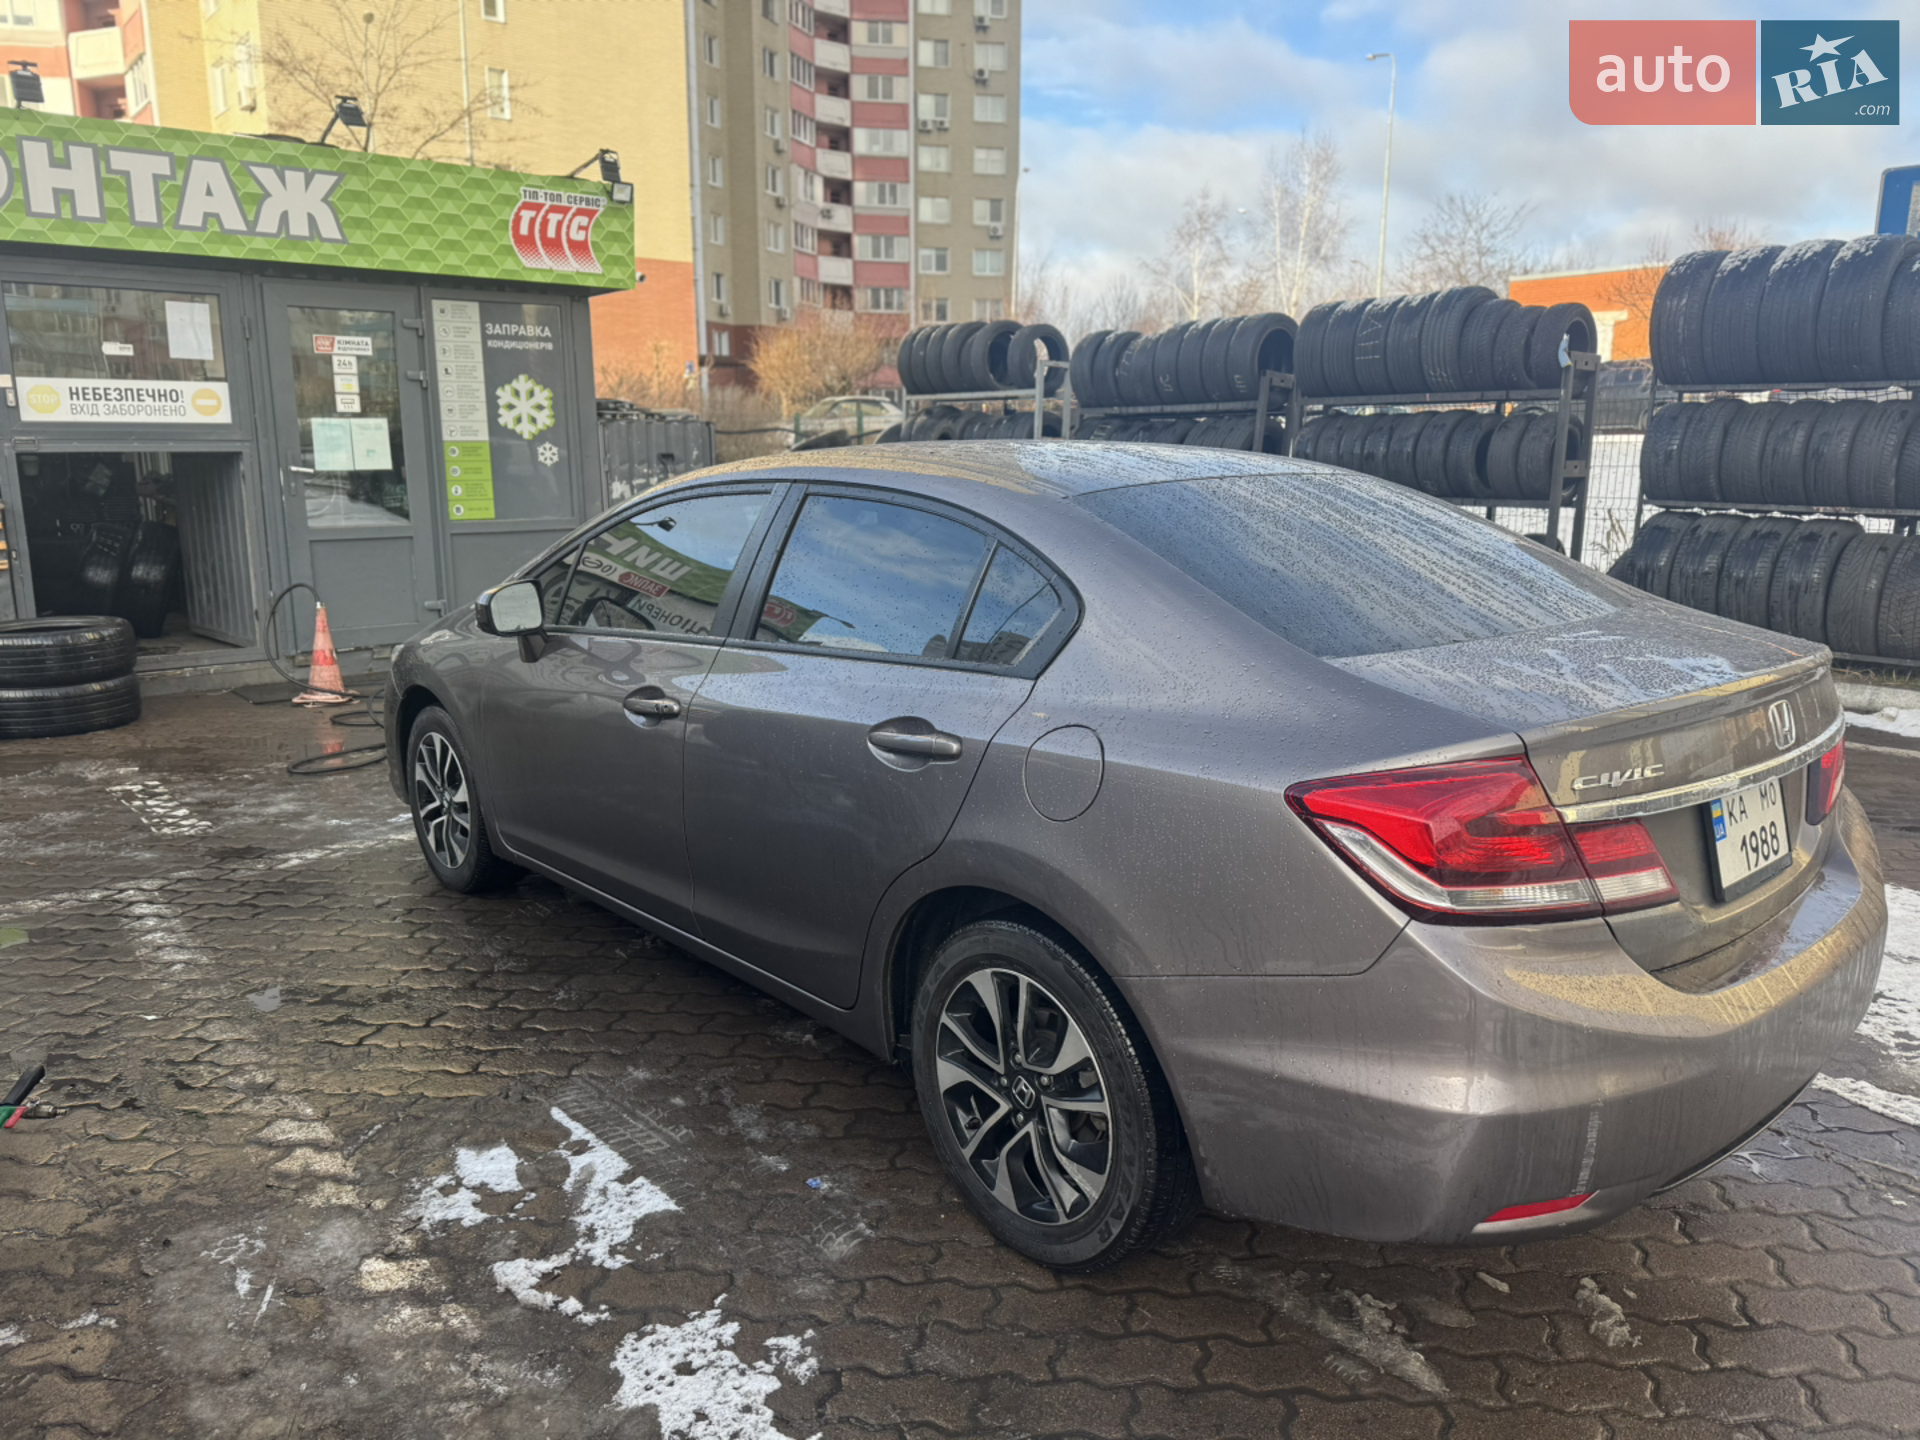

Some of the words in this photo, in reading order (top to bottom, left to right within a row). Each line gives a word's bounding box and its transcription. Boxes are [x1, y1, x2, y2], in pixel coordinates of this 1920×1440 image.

[0, 134, 348, 244] НТАЖ
[485, 322, 552, 338] ЗАПРАВКА
[337, 359, 353, 367] 24h
[29, 392, 60, 404] STOP
[68, 386, 185, 404] НЕБЕЗПЕЧНО!
[70, 403, 101, 417] ВХІД
[103, 403, 187, 417] ЗАБОРОНЕНО
[1572, 763, 1665, 790] CIVIC
[1726, 795, 1748, 827] KA
[1759, 782, 1776, 811] MO
[1740, 821, 1780, 871] 1988
